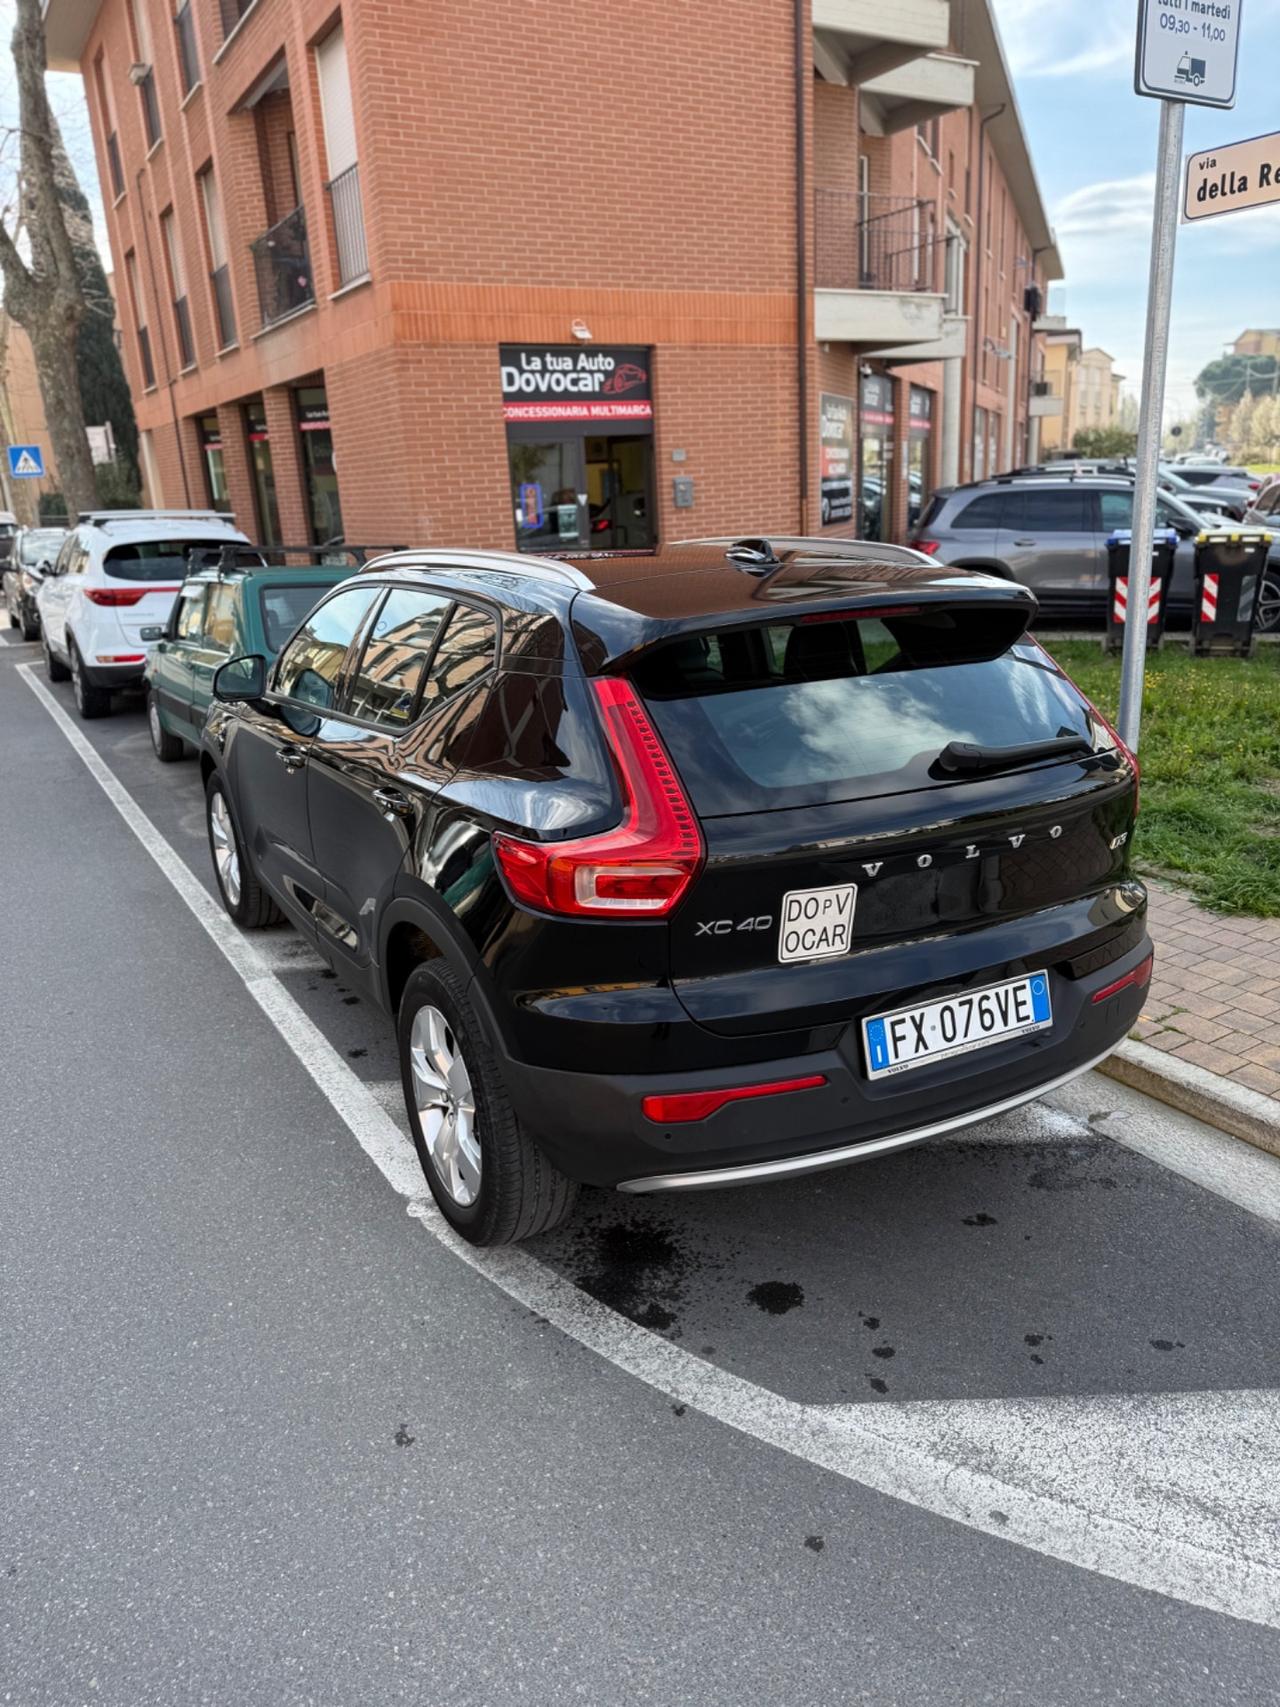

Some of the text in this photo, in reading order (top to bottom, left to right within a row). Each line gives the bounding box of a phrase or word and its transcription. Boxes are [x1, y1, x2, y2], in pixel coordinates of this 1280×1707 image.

[1160, 13, 1190, 34] 09,30
[1201, 22, 1226, 42] 11,00
[1199, 157, 1217, 170] via
[1197, 171, 1248, 202] della
[520, 352, 615, 370] La tua Auto
[501, 366, 605, 393] Dovocar
[590, 404, 652, 417] MULTIMARCA
[861, 825, 1063, 878] VOLVO
[785, 924, 846, 953] OCAR
